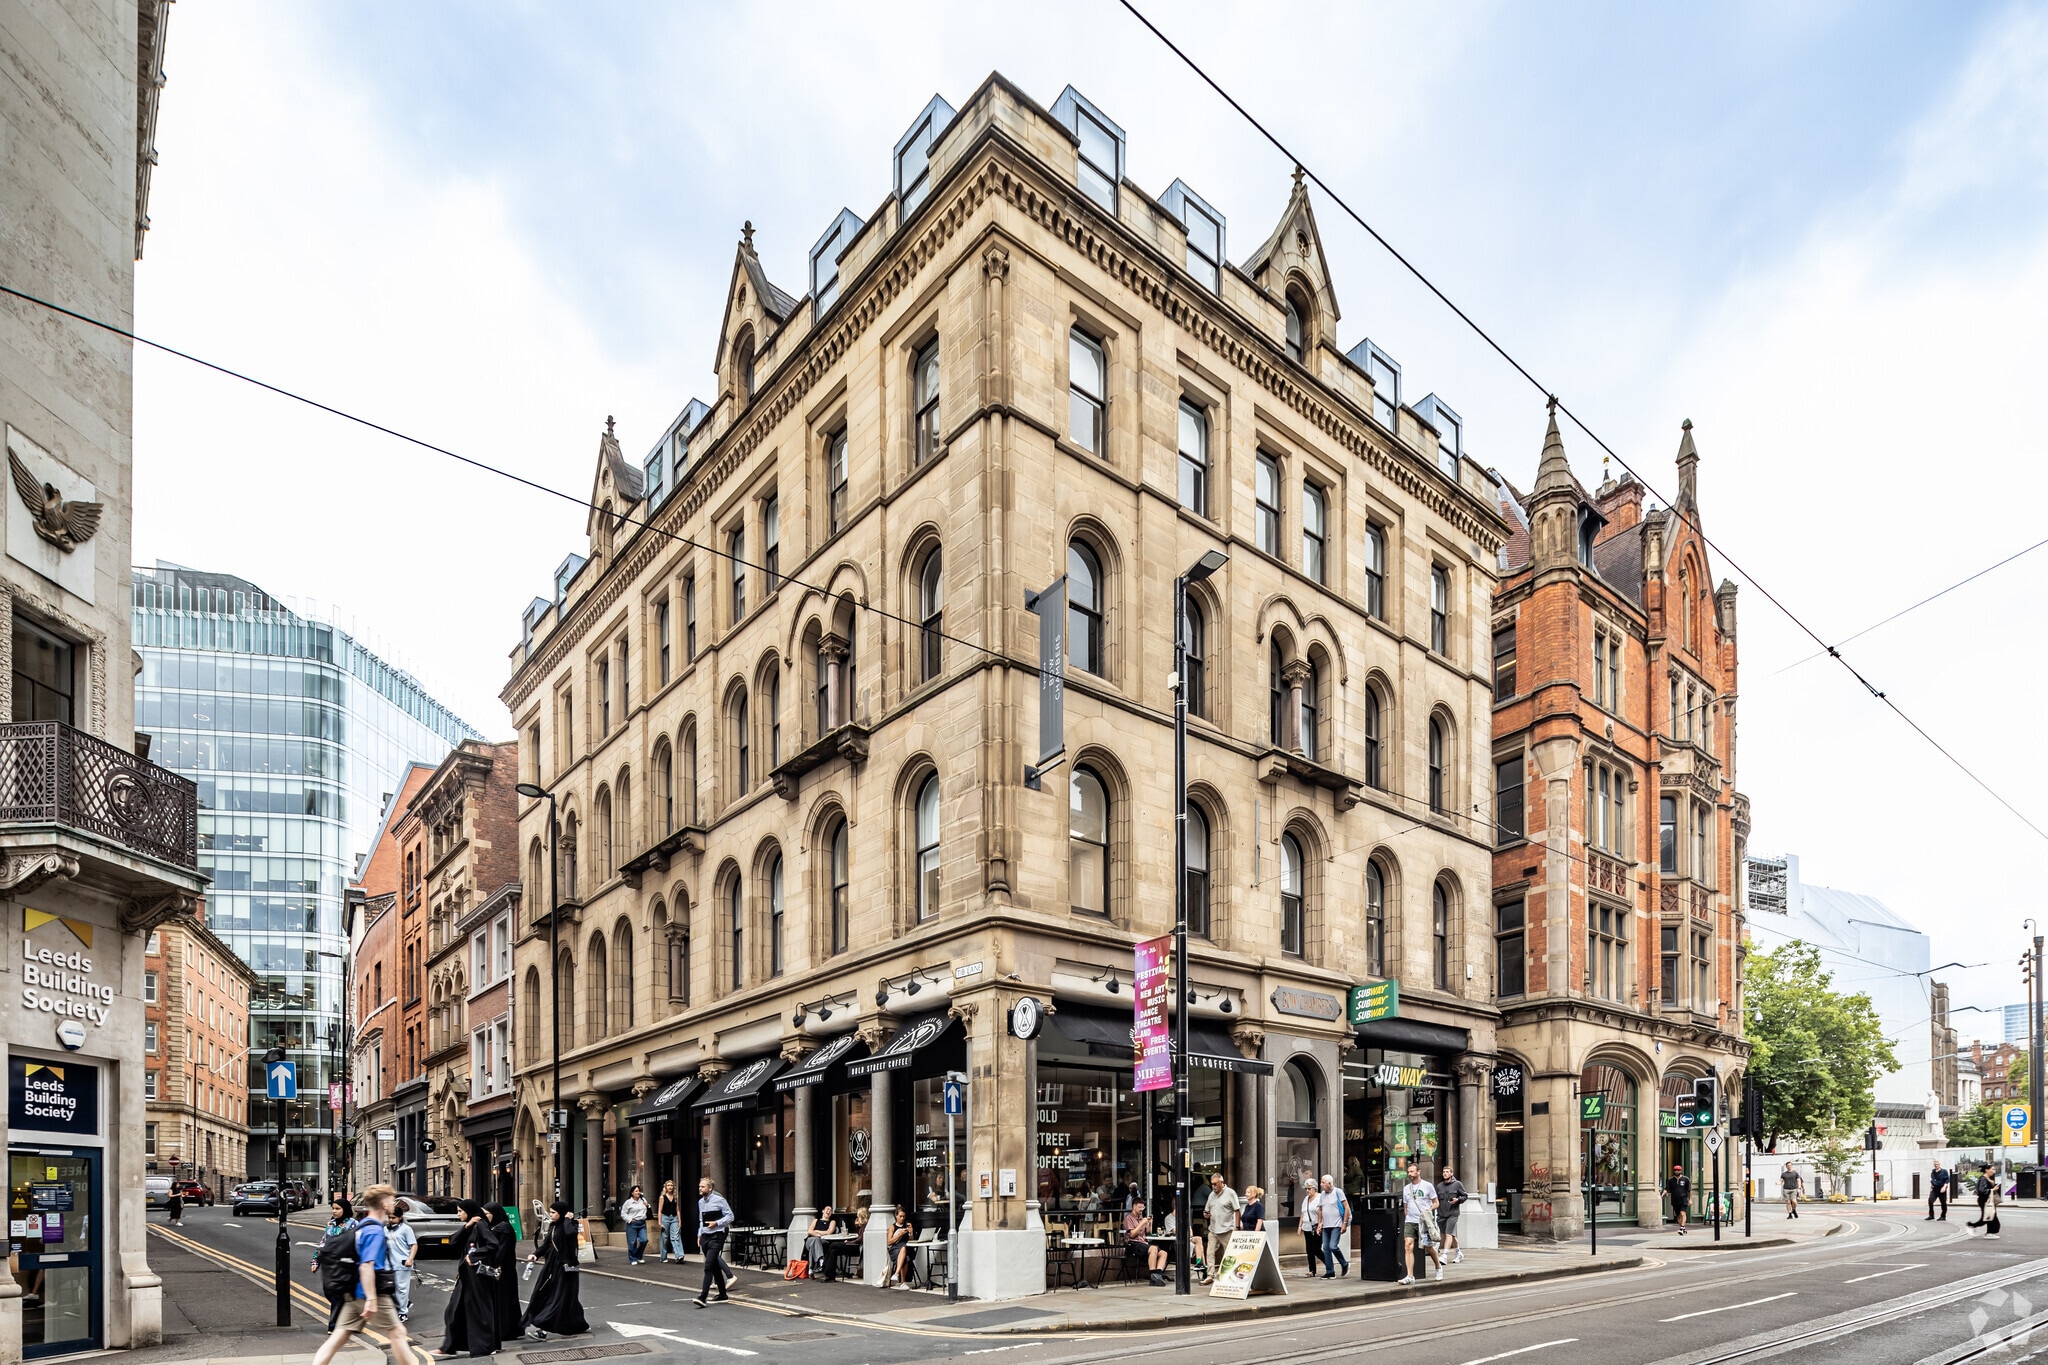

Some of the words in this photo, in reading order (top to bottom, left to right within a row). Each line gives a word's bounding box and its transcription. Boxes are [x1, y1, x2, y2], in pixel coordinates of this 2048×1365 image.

[24, 939, 93, 973] Leeds
[1158, 956, 1164, 964] A
[1136, 965, 1166, 980] FESTIVAL
[24, 963, 114, 1005] Building
[1140, 980, 1148, 990] OF
[1140, 989, 1152, 999] NEW
[1154, 984, 1165, 995] ART
[1356, 984, 1389, 1000] SUBWAY
[23, 988, 110, 1027] Society
[1147, 994, 1166, 1007] MUSIC
[1282, 991, 1297, 1009] BOW
[1300, 994, 1335, 1017] CHAMBERS
[1356, 995, 1389, 1010] SUBWAY
[1140, 1006, 1158, 1018] DANCE
[1356, 1006, 1389, 1021] SUBWAY
[1136, 1015, 1162, 1029] THEATRE
[1140, 1028, 1152, 1038] AND
[1150, 1034, 1166, 1046] FREE
[1143, 1045, 1166, 1057] EVENTS
[852, 1066, 864, 1076] BOLD
[866, 1062, 886, 1073] STREET
[888, 1058, 908, 1068] COFFEE
[1202, 1058, 1232, 1070] COFFEE
[789, 1078, 805, 1088] STREET
[806, 1074, 823, 1084] COFFEE
[1136, 1068, 1156, 1080] MIF
[1375, 1064, 1428, 1086] SUBWAY
[1494, 1068, 1508, 1080] SALT
[1509, 1068, 1521, 1080] DOG
[25, 1076, 65, 1092] Leeds
[25, 1090, 77, 1109] Building
[24, 1103, 75, 1122] Society
[916, 1124, 930, 1134] BOLD
[916, 1140, 938, 1152] STREET
[1036, 1132, 1070, 1146] TREET
[916, 1156, 938, 1168] COFFEE
[1036, 1156, 1070, 1169] OFFEE
